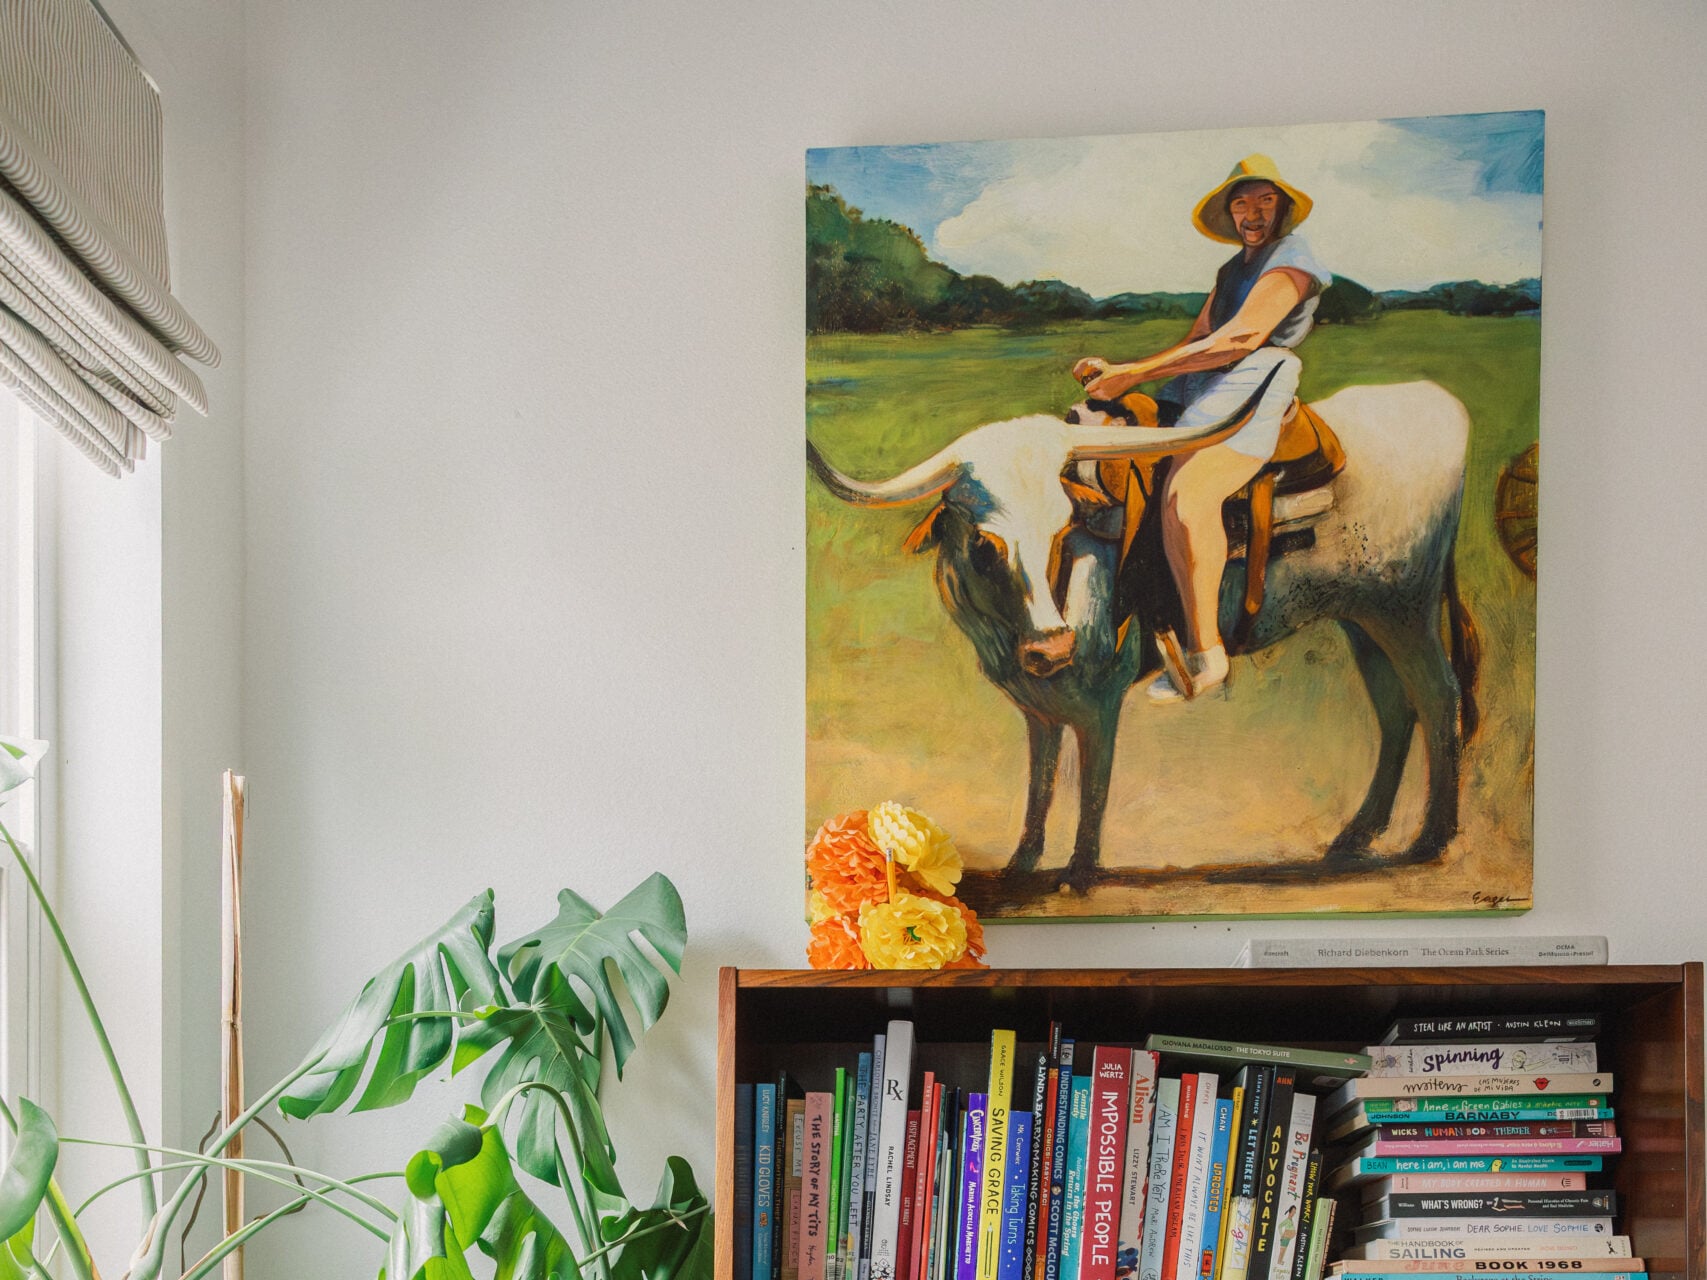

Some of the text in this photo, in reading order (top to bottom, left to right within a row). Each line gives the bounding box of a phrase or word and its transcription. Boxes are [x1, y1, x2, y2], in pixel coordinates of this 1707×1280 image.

[1318, 947, 1409, 958] Richard Diebenkorn
[1421, 947, 1509, 956] The Ocean Park Series
[1414, 1022, 1436, 1032] STEAL
[1438, 1022, 1452, 1031] LIKE
[1456, 1022, 1466, 1030] AN
[1468, 1021, 1492, 1031] ARTIST
[999, 1045, 1007, 1067] GRACE
[1193, 1042, 1232, 1051] MADALOSSO
[1249, 1048, 1272, 1056] TOKYO
[1101, 1063, 1122, 1071] JULIA
[1422, 1048, 1505, 1073] Spinning
[1100, 1071, 1124, 1079] WERTZ
[1276, 1076, 1293, 1085] AHN
[1055, 1070, 1069, 1144] UNDERSTANDING
[1132, 1072, 1150, 1124] Alison
[1423, 1103, 1448, 1111] Anne
[812, 1115, 822, 1139] THE
[1445, 1111, 1520, 1121] BARNABY
[990, 1107, 1004, 1162] SAVING
[1391, 1127, 1530, 1136] WICKS HUMAN THEATER
[906, 1120, 917, 1169] DISPLACEMENT
[1026, 1066, 1046, 1245] LYNDA BARRY MAKING COMICS
[808, 1142, 821, 1175] STORY
[1053, 1145, 1066, 1179] COMICS
[1208, 1107, 1228, 1213] CHAN UPROOTED
[1242, 1129, 1257, 1196] LET THERE BE
[1286, 1131, 1309, 1201] Be Pregnant
[1396, 1160, 1419, 1170] here
[1453, 1161, 1469, 1169] am
[1471, 1161, 1485, 1169] me
[758, 1145, 771, 1207] KID GLOVES
[809, 1178, 818, 1190] OF
[849, 1134, 862, 1228] AFTER YOU LEFT
[884, 1146, 894, 1207] RACHEL LINDSAY
[1091, 1092, 1119, 1266] IMPOSSIBLE PEOPLE
[1129, 1171, 1138, 1205] STEWART
[1257, 1125, 1281, 1252] ADVOCATE
[1515, 1178, 1547, 1187] HUMAN
[808, 1193, 819, 1208] MY
[986, 1169, 1000, 1215] GRACE
[1422, 1200, 1449, 1209] WHAT'S
[1451, 1200, 1483, 1209] WRONG?
[1005, 1184, 1026, 1245] Taking Turns
[1049, 1199, 1060, 1234] SCOTT
[1183, 1175, 1201, 1268] ALWAYS LIKE THIS
[1296, 1162, 1318, 1277] SHOW AUSTIN KLEON
[1467, 1223, 1588, 1233] DEAR LOVE SOPHIE
[1389, 1248, 1465, 1259] SAILING
[1475, 1261, 1528, 1270] BOOK
[1538, 1261, 1582, 1269] 1968
